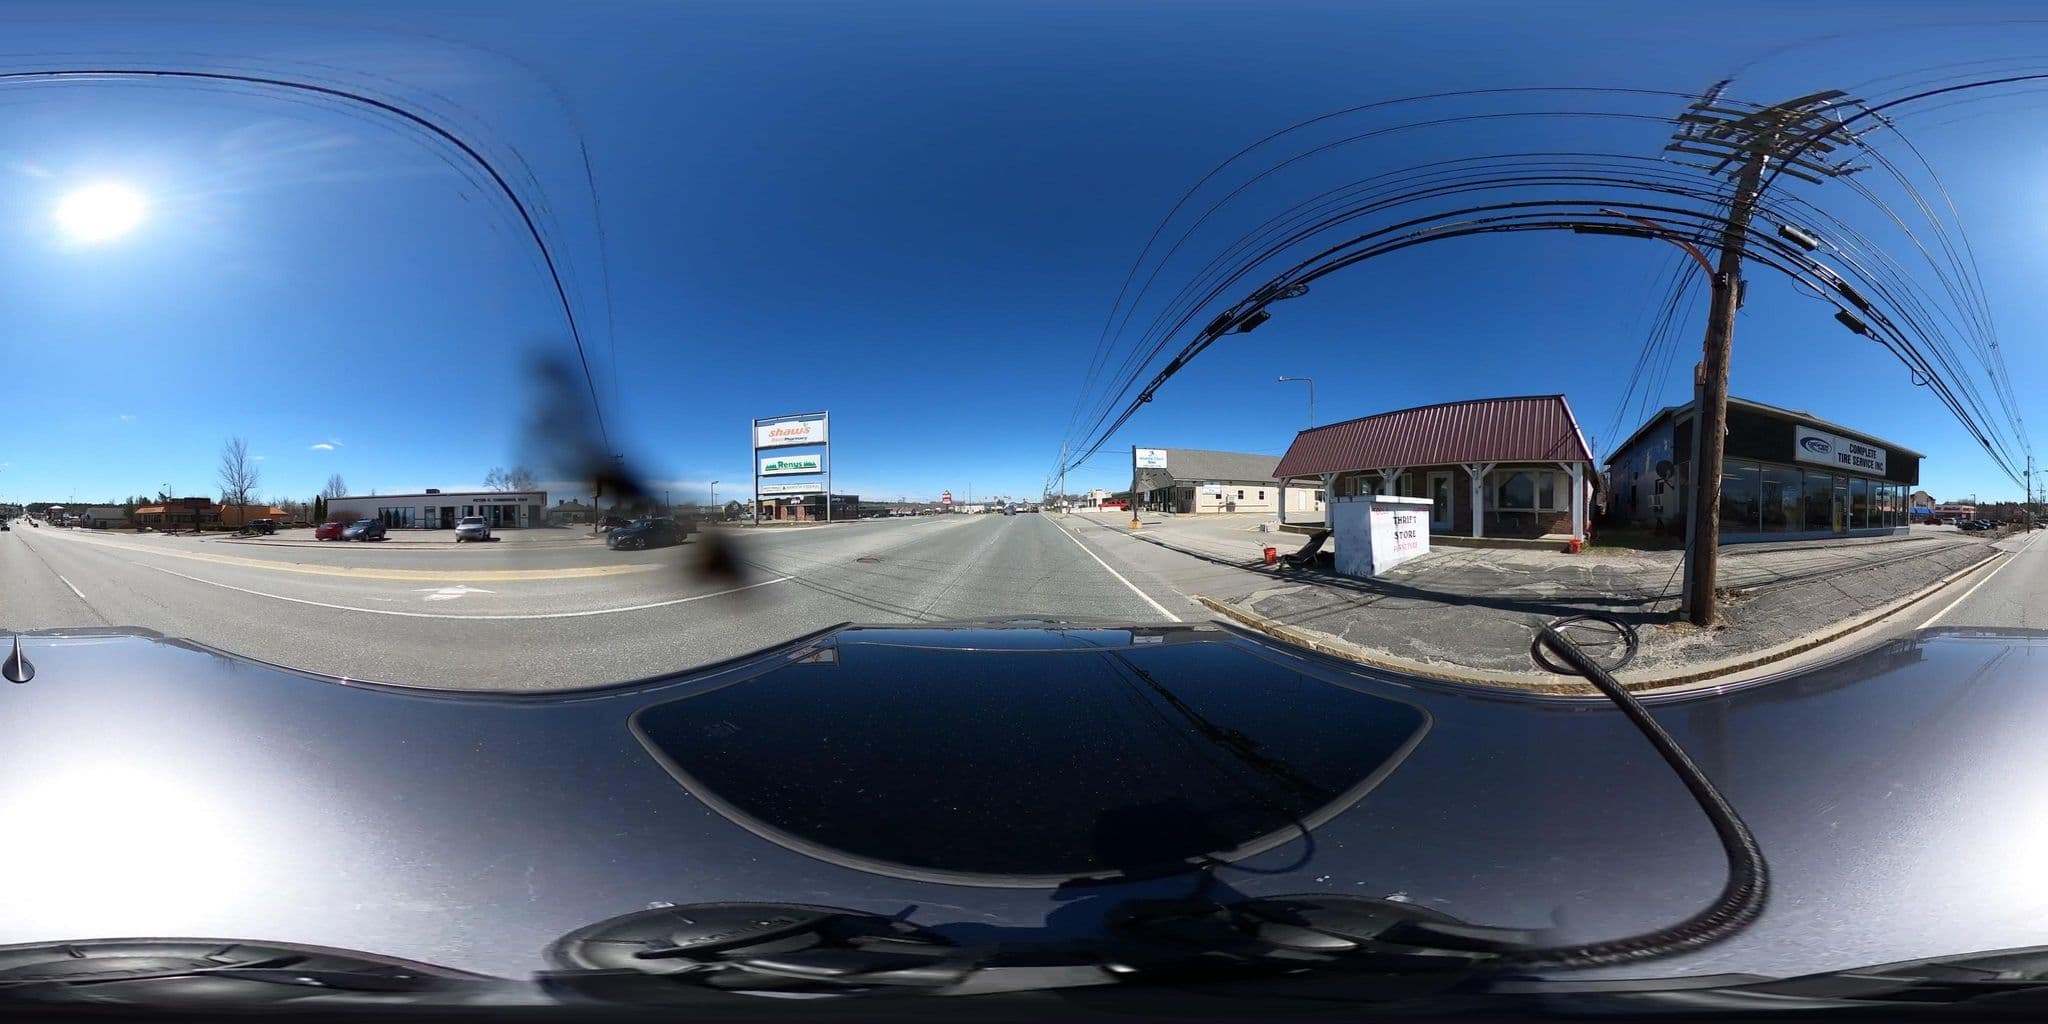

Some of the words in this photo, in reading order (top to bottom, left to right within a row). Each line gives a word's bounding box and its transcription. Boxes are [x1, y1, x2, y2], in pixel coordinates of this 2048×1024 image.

[1850, 443, 1876, 459] COMPLETE
[777, 461, 803, 469] Renys
[1838, 452, 1852, 465] TIRE
[1852, 455, 1874, 469] SERVICE
[1393, 515, 1417, 525] THRIFT
[1394, 530, 1416, 540] STORE
